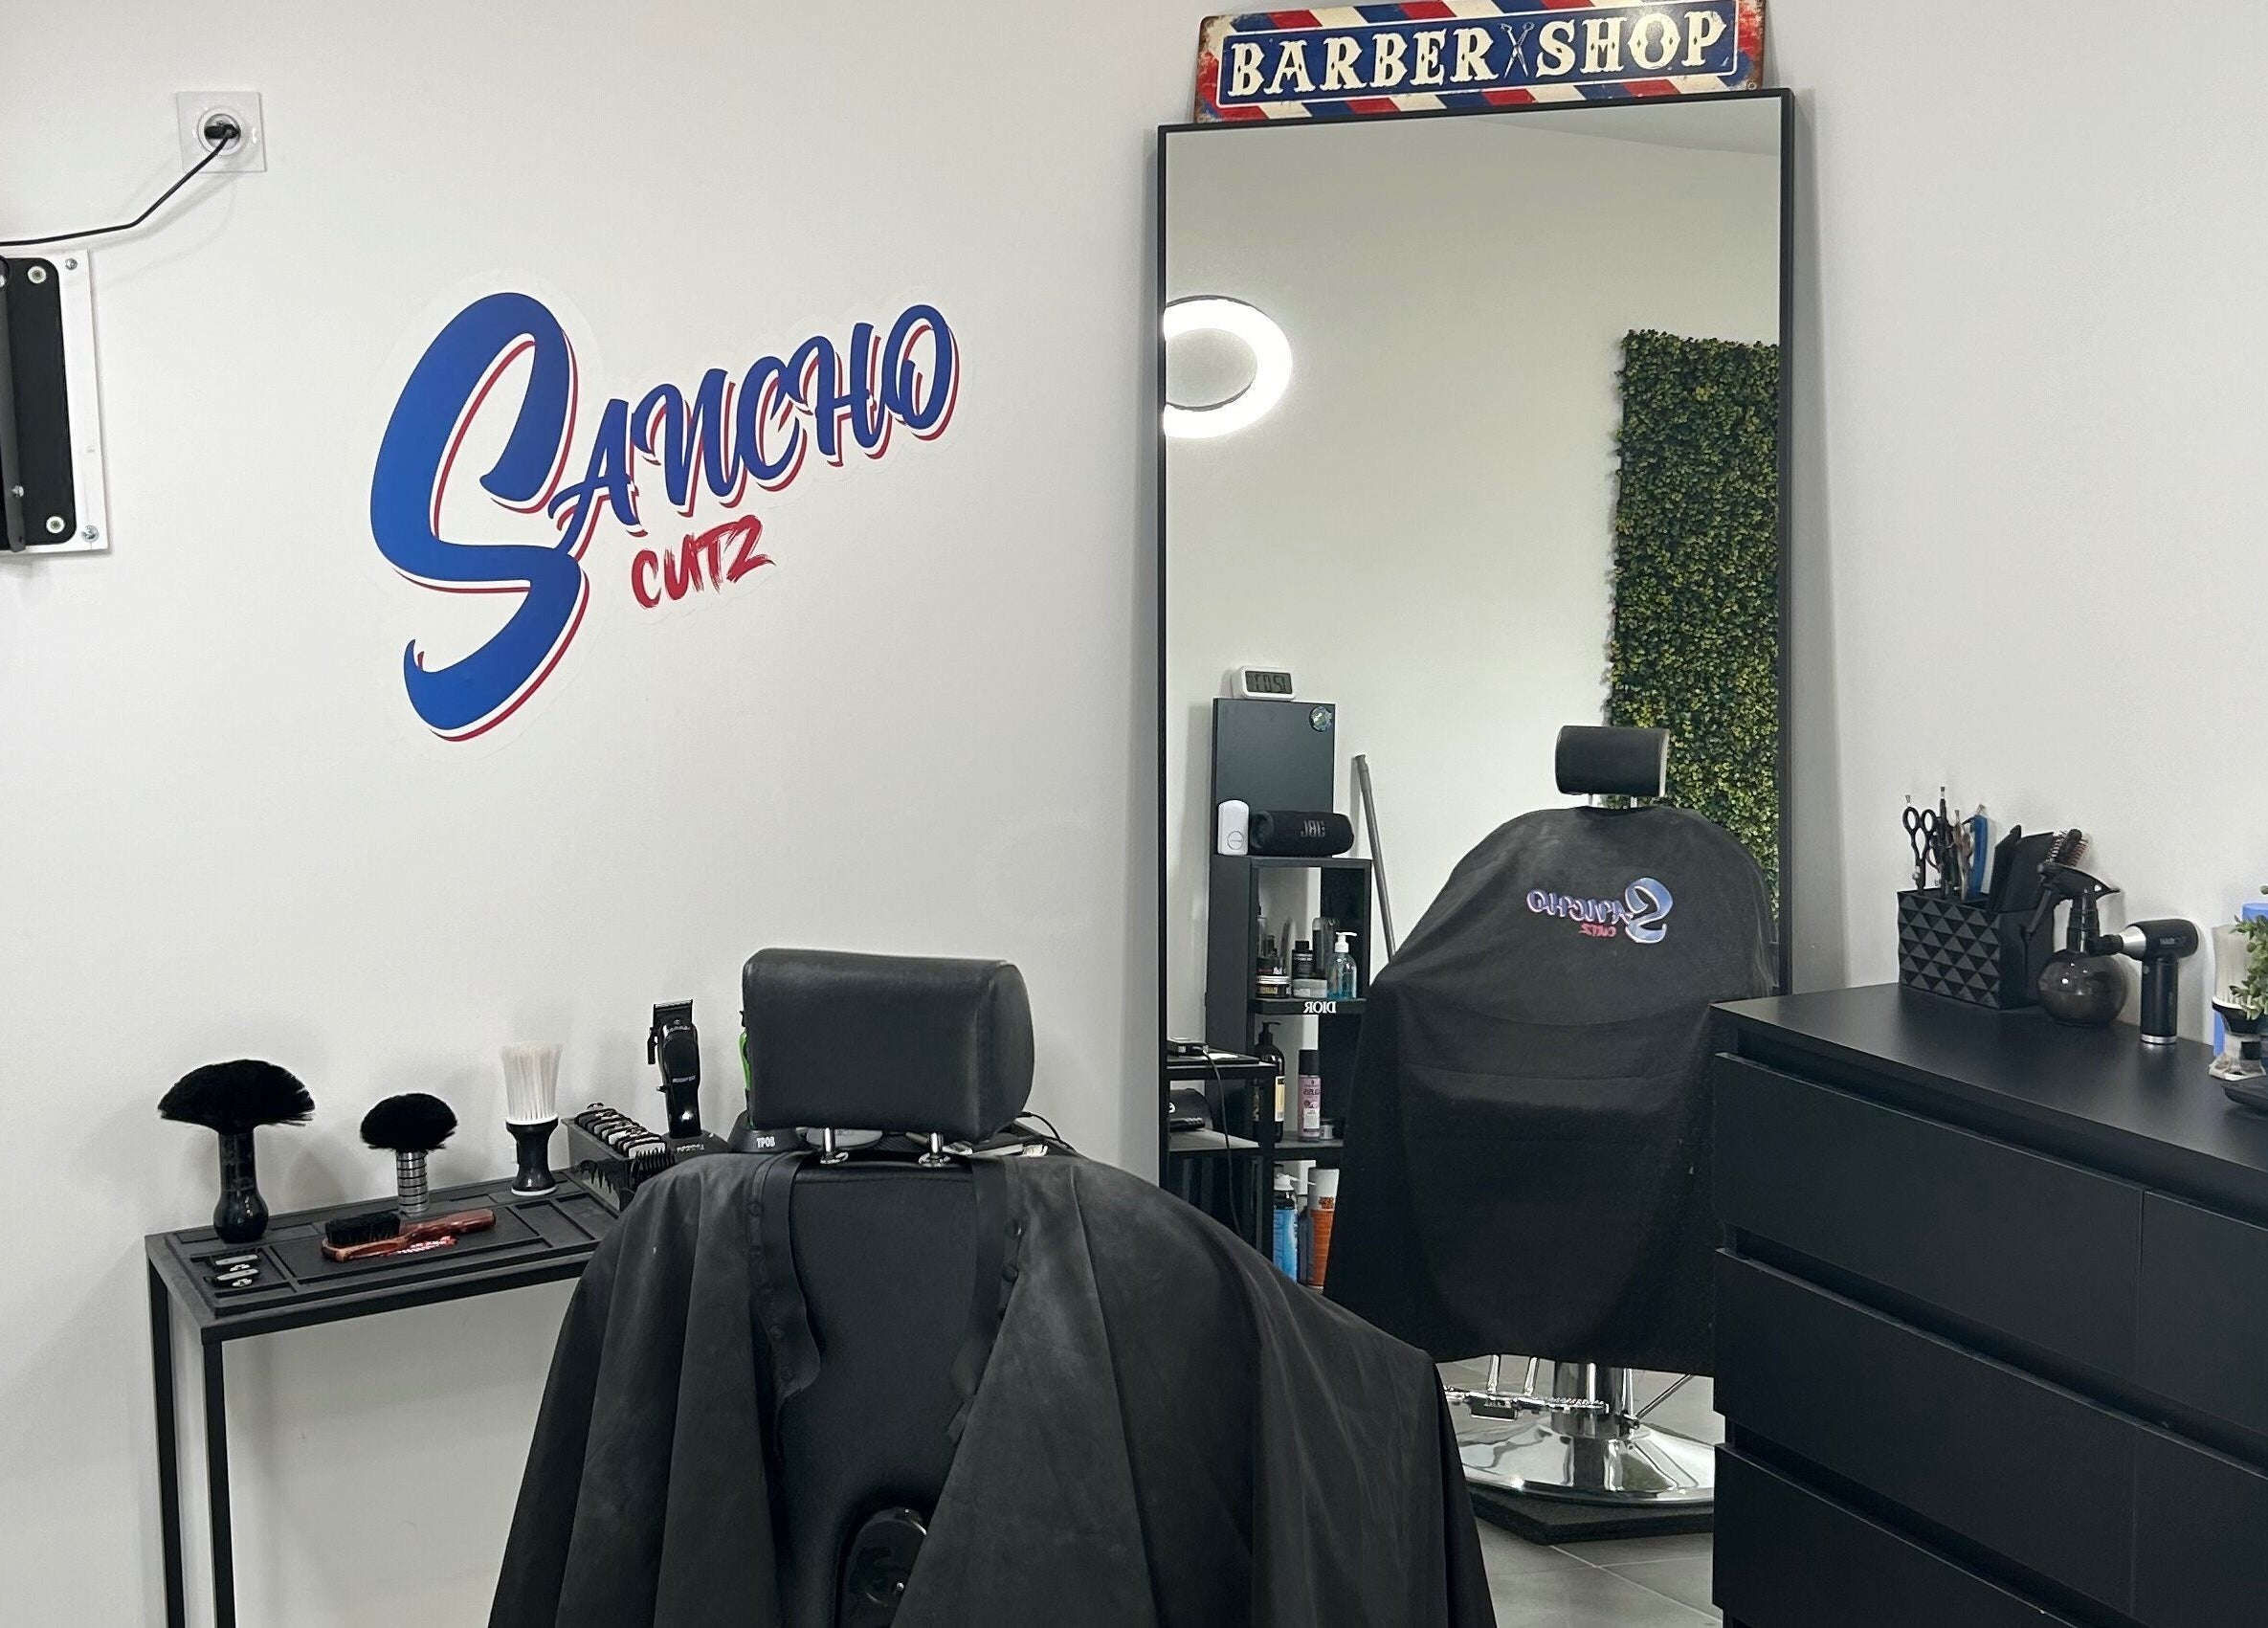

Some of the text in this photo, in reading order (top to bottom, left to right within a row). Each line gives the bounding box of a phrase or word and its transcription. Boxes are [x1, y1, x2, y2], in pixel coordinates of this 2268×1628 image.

[1227, 11, 1728, 99] BARBER SHOP
[369, 292, 960, 742] SANCHO
[631, 514, 776, 609] CUTZ
